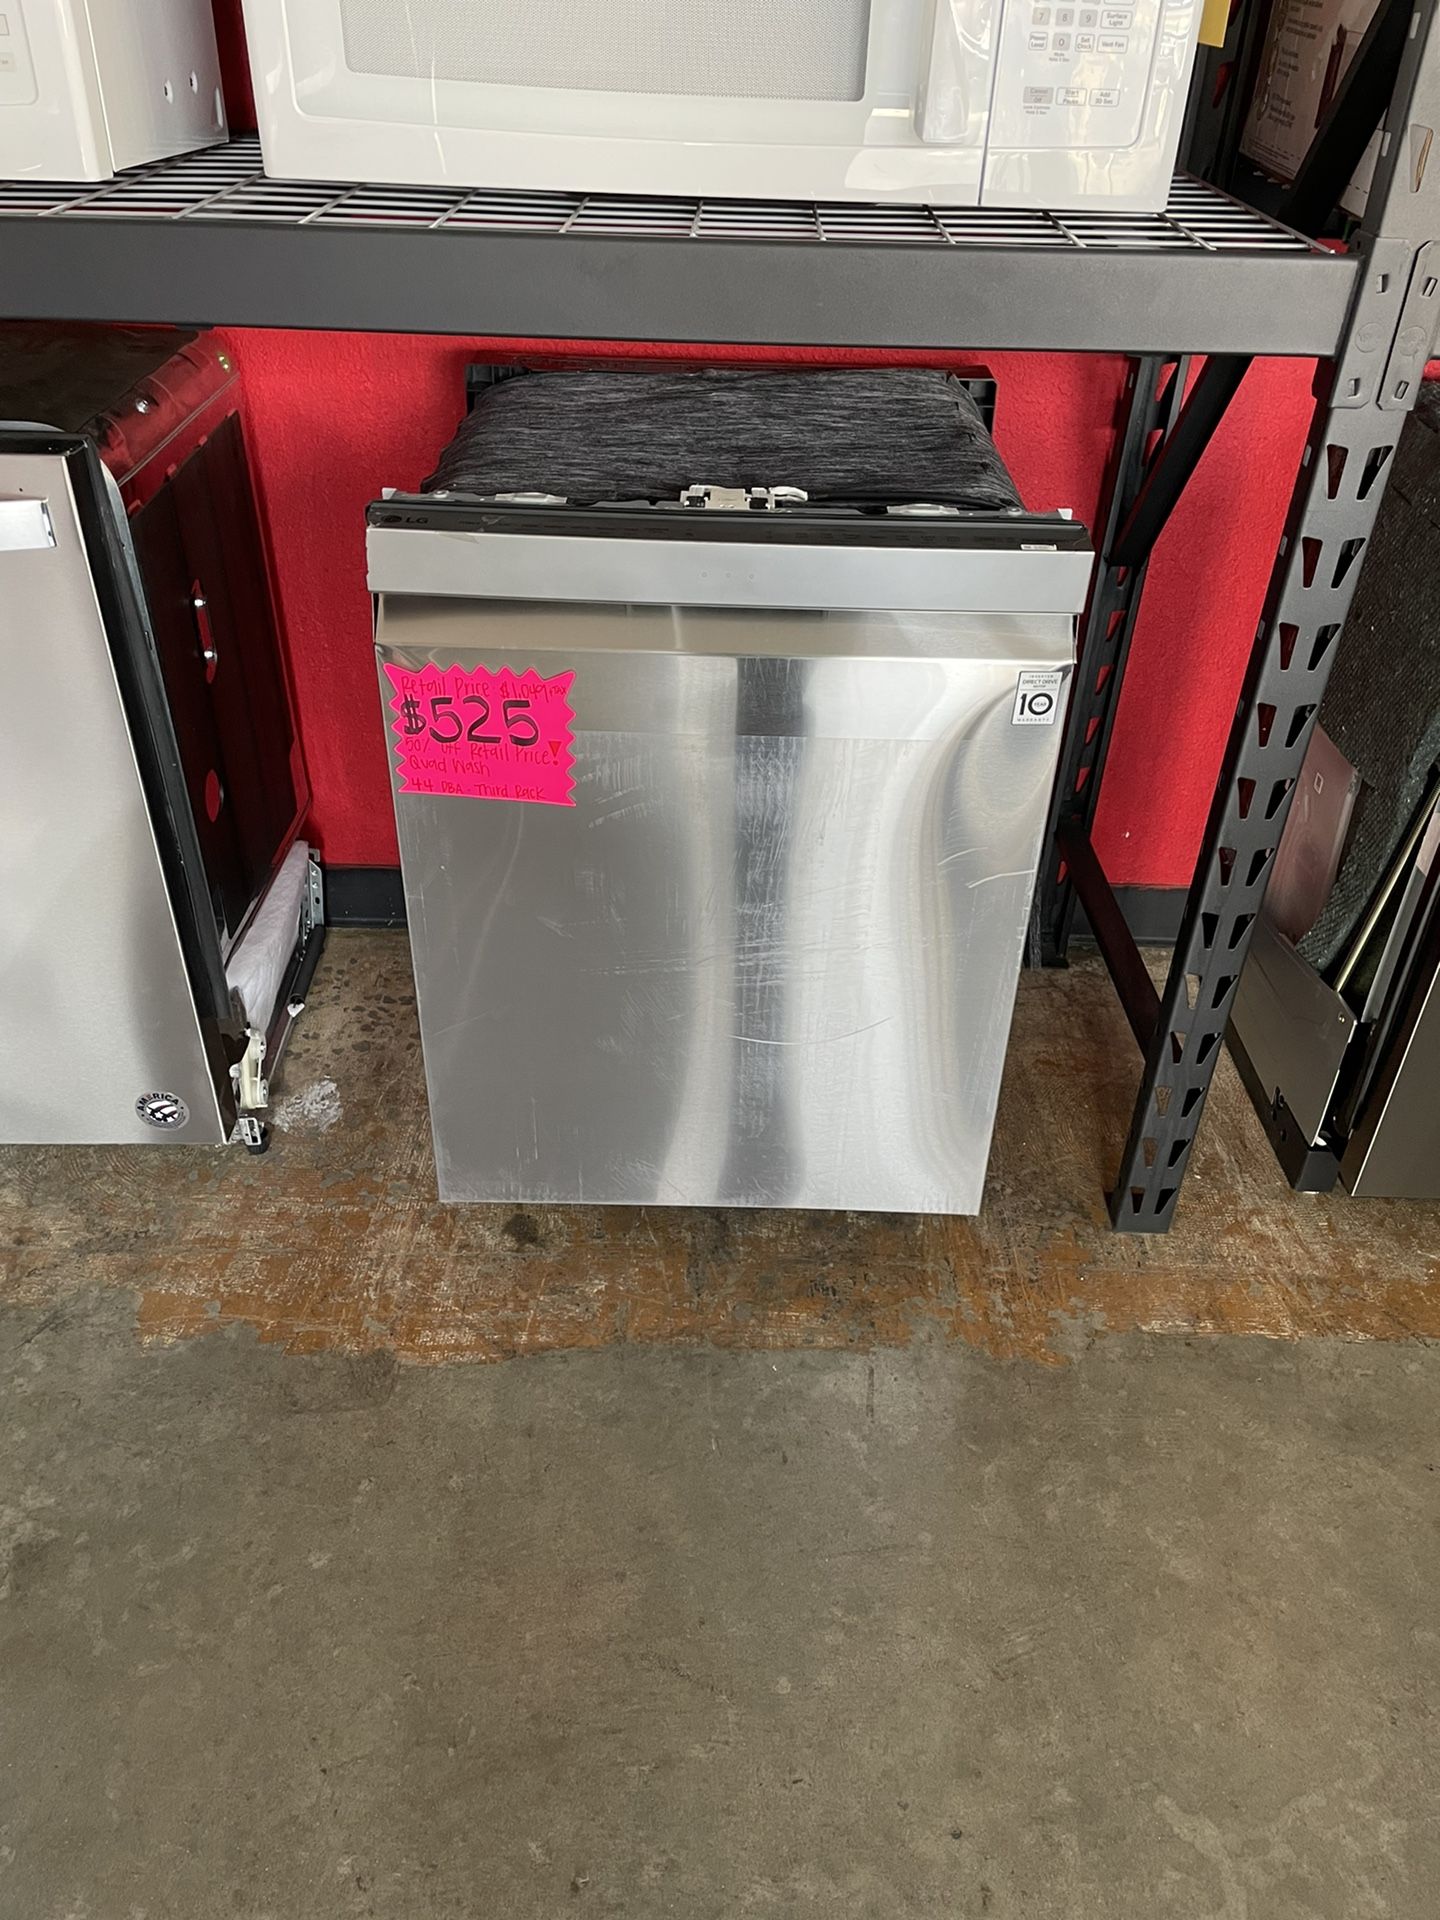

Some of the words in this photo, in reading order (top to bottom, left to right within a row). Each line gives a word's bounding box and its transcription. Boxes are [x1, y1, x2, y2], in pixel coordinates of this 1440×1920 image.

[1058, 38, 1065, 47] 0
[405, 516, 429, 524] LG
[400, 676, 446, 698] Retail
[454, 677, 491, 699] Price
[1019, 692, 1054, 716] 10
[401, 694, 540, 747] $525
[405, 737, 431, 753] 50%
[470, 742, 510, 763] Retail
[409, 755, 448, 774] Quad
[453, 759, 492, 778] Wash
[411, 777, 434, 792] 44
[473, 784, 509, 799] Third
[514, 783, 547, 800] Rack
[136, 1092, 180, 1112] AMERICA
